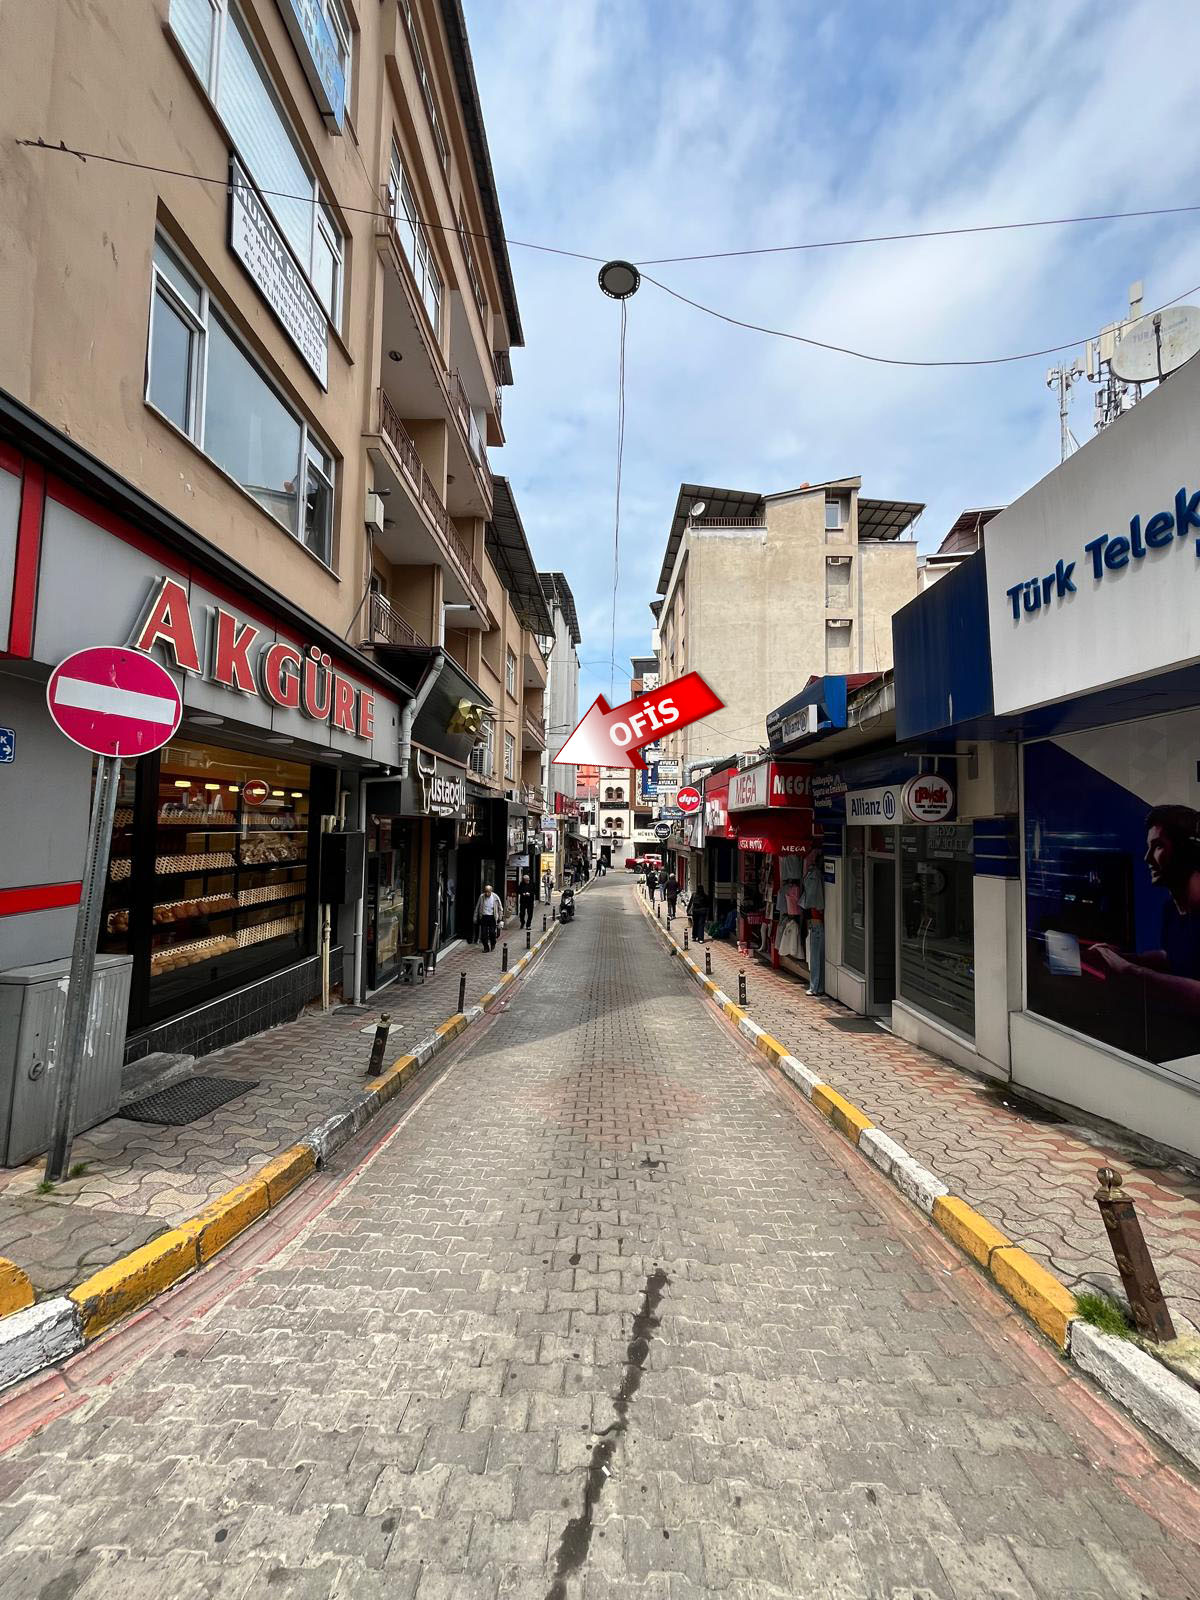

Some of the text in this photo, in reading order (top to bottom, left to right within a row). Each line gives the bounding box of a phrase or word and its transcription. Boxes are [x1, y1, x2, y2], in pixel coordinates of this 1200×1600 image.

[236, 173, 324, 341] HUKUK BÜROSU
[1006, 559, 1077, 620] Türk
[136, 575, 376, 741] AKGÜRE
[678, 794, 699, 806] dyo
[735, 773, 757, 805] MEGA
[851, 797, 881, 817] Allianz
